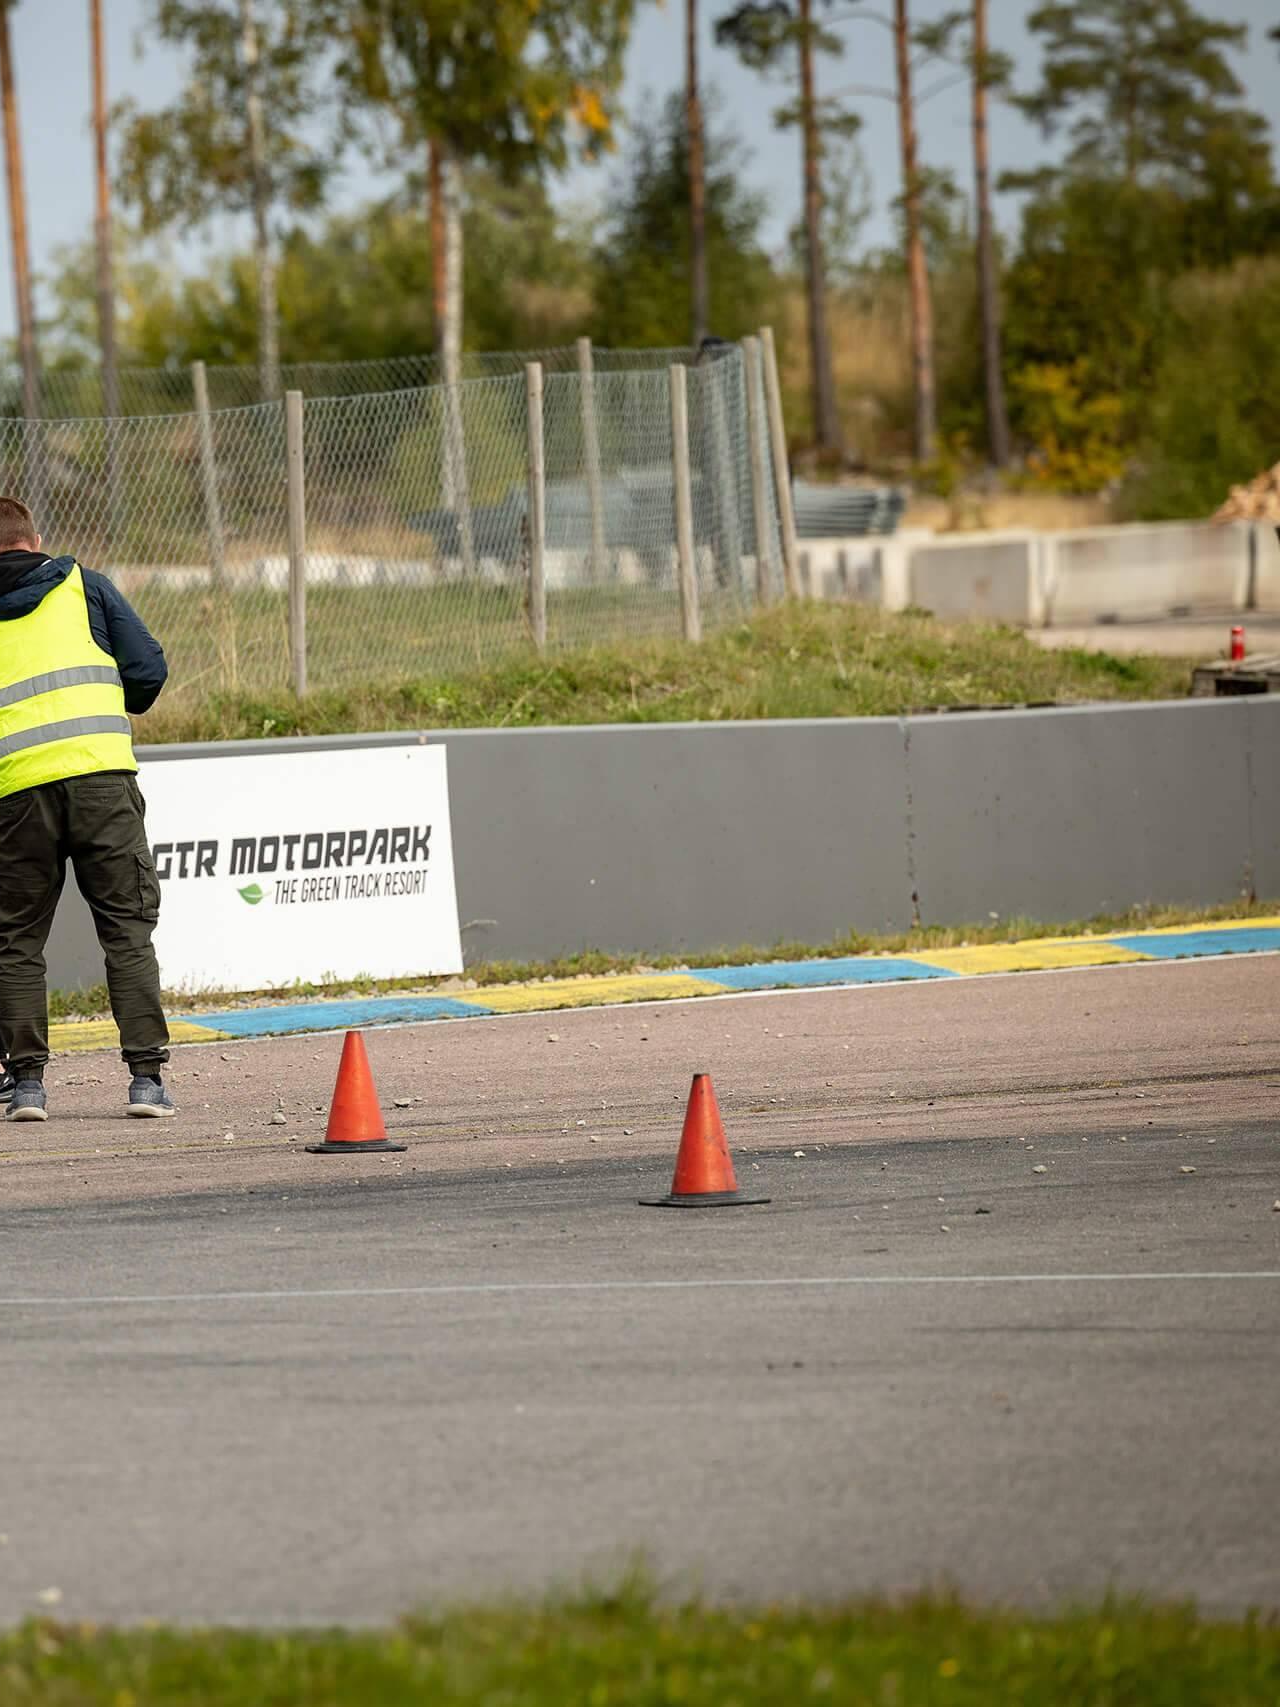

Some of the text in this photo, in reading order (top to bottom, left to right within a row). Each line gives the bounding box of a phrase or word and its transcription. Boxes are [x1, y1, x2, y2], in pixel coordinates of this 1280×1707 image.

[152, 825, 431, 880] GTR MOTORPARK
[275, 870, 428, 904] THE GREEN TRACK RESORT
